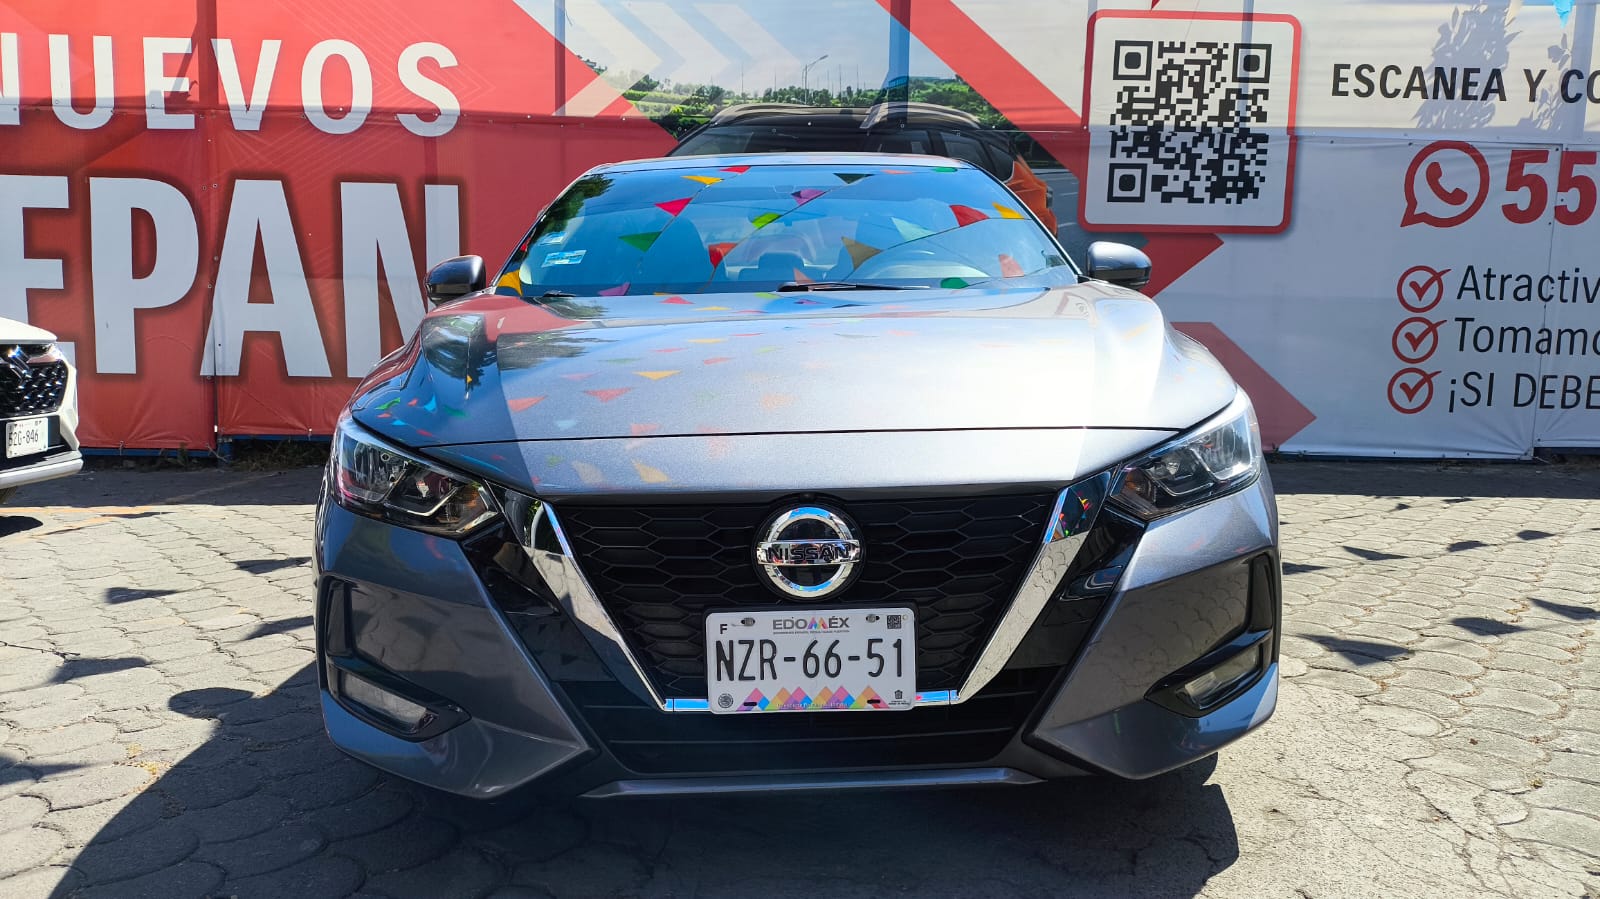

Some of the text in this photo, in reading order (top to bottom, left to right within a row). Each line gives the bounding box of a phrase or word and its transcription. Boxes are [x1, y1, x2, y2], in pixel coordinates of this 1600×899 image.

[1332, 63, 1506, 101] ESCANEA
[1524, 69, 1548, 102] Y
[1501, 150, 1597, 225] 55
[1457, 265, 1600, 304] Atractiv
[1449, 371, 1600, 413] ¡SI DEBE
[767, 544, 851, 560] NISSAN
[720, 623, 728, 634] F
[715, 638, 903, 681] NZR-66-51
